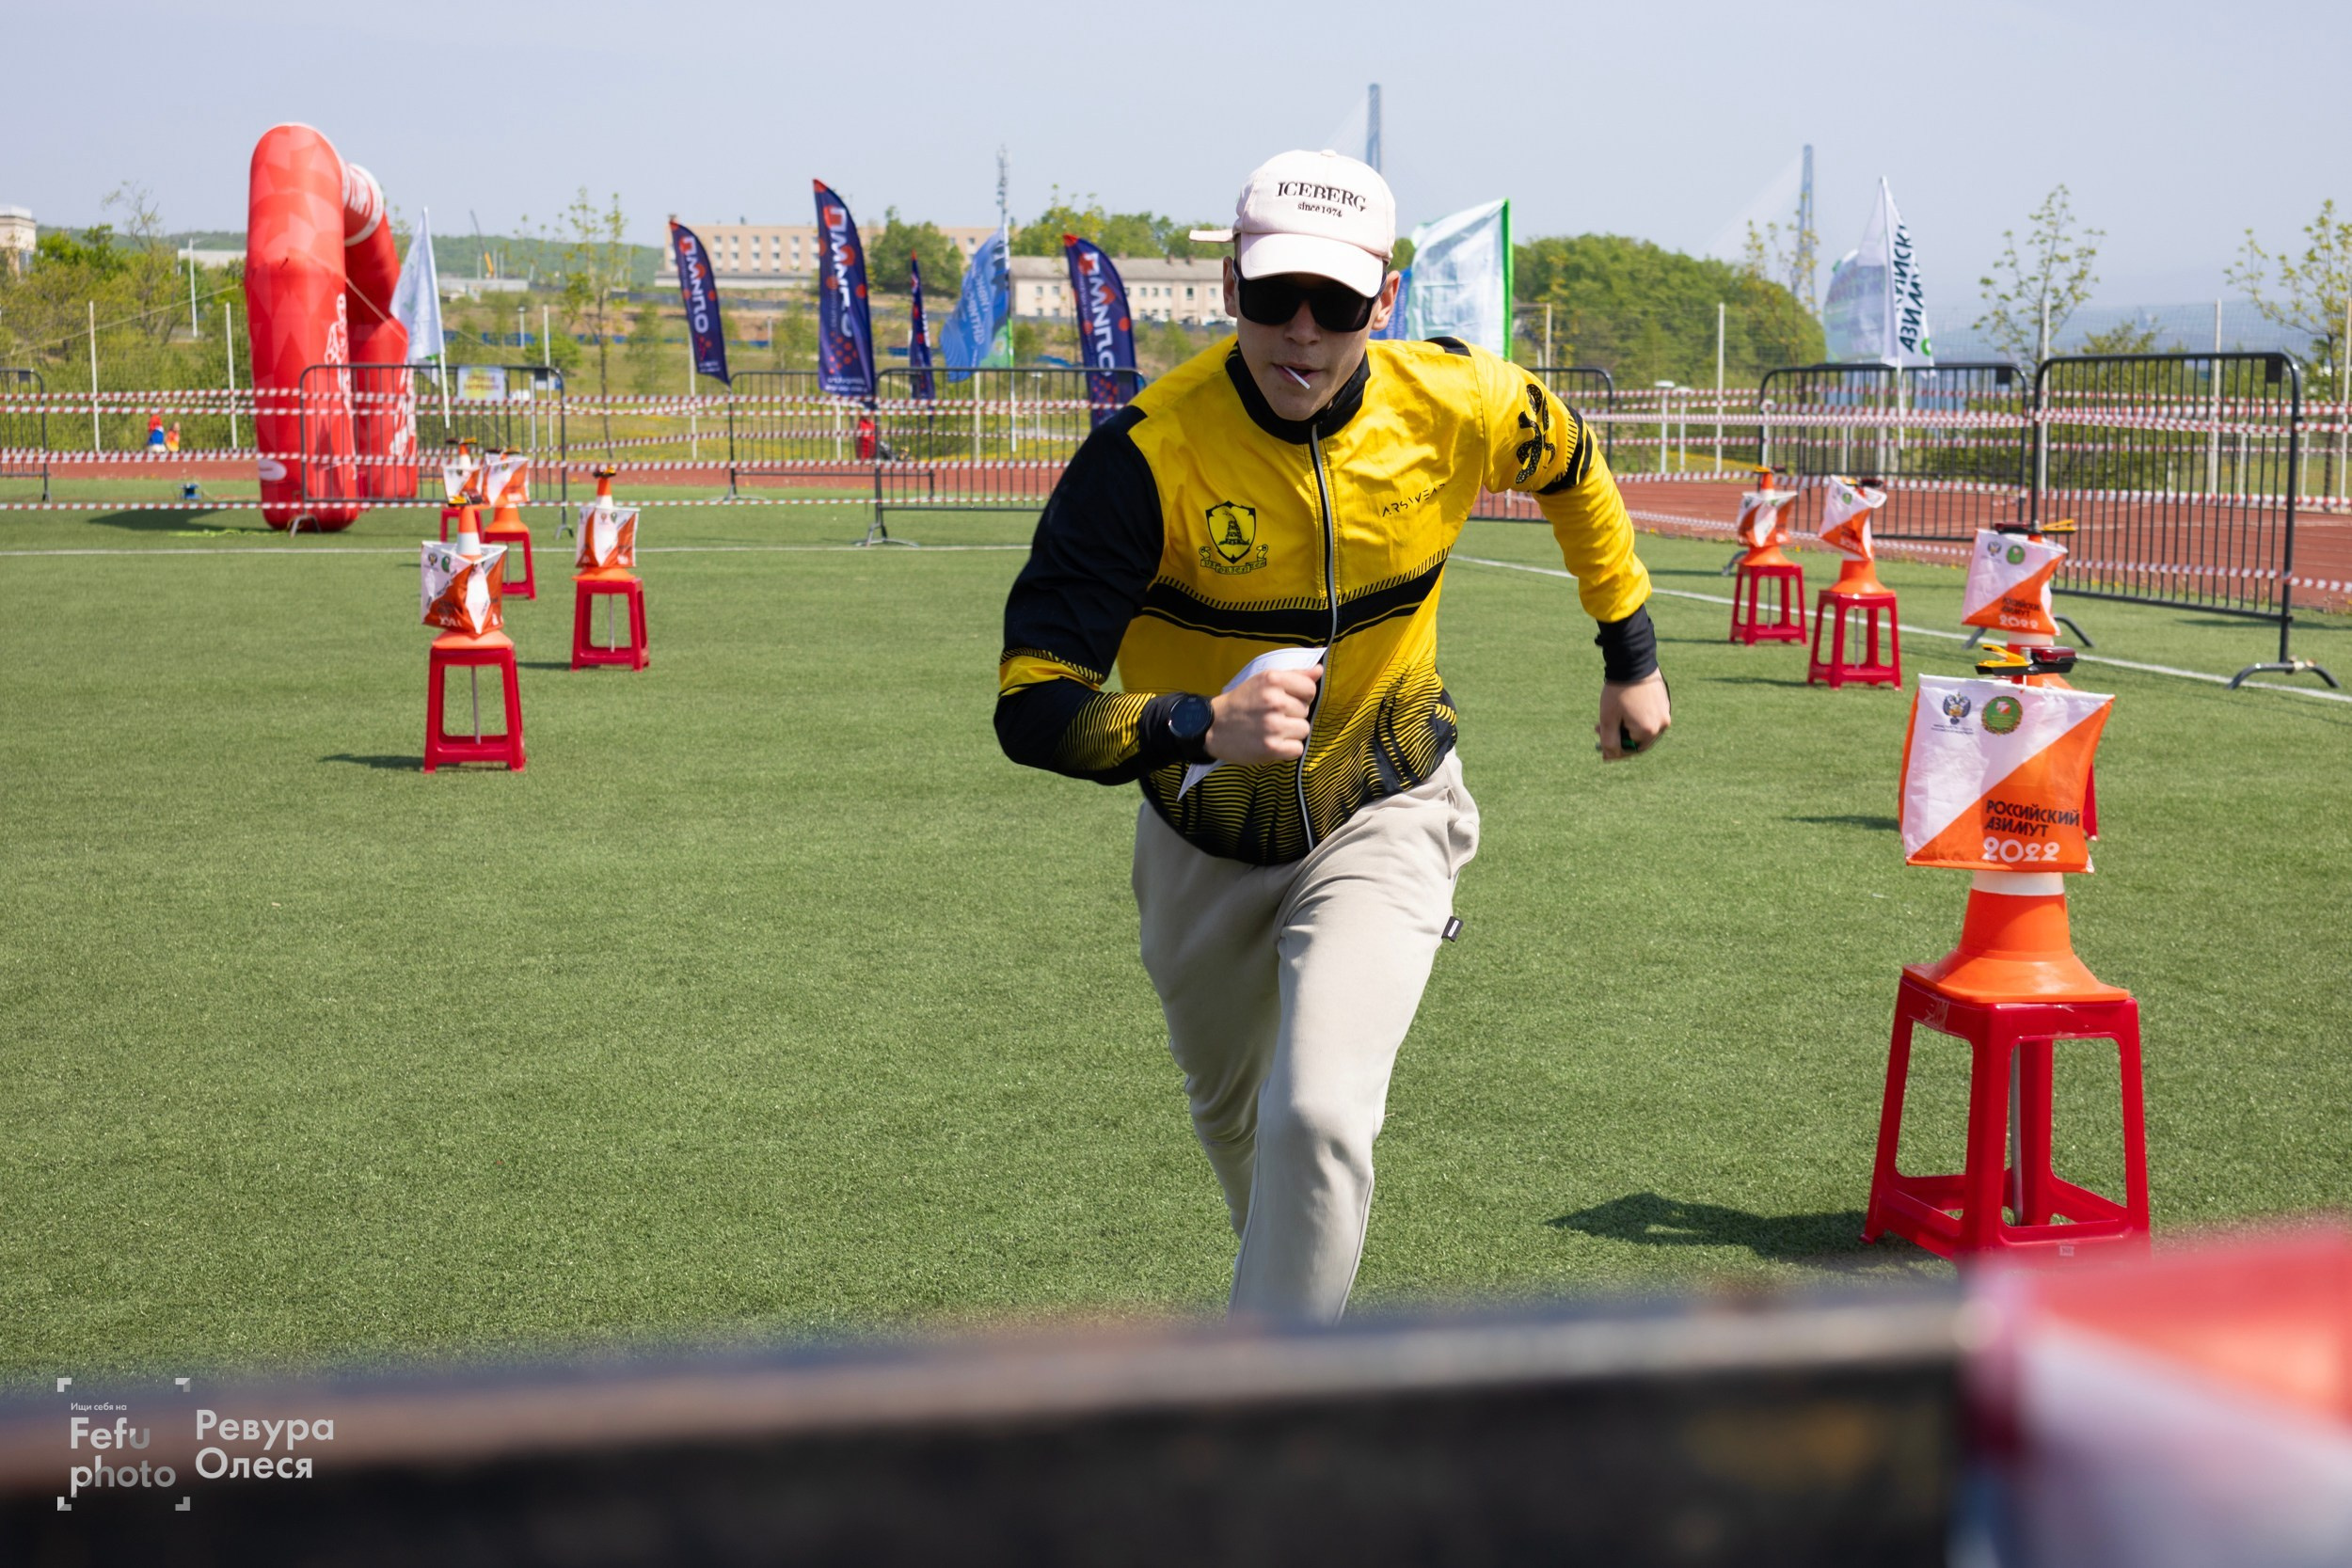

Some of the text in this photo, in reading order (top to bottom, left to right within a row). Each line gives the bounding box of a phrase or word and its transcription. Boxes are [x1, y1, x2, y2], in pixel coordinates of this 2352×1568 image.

[1277, 182, 1366, 213] ICEBERG
[1297, 201, 1343, 218] since 1974
[1984, 816, 2049, 837] АЗИМУТ
[1986, 800, 2079, 827] РОССИЙСКИЙ
[1981, 836, 2060, 863] 2022
